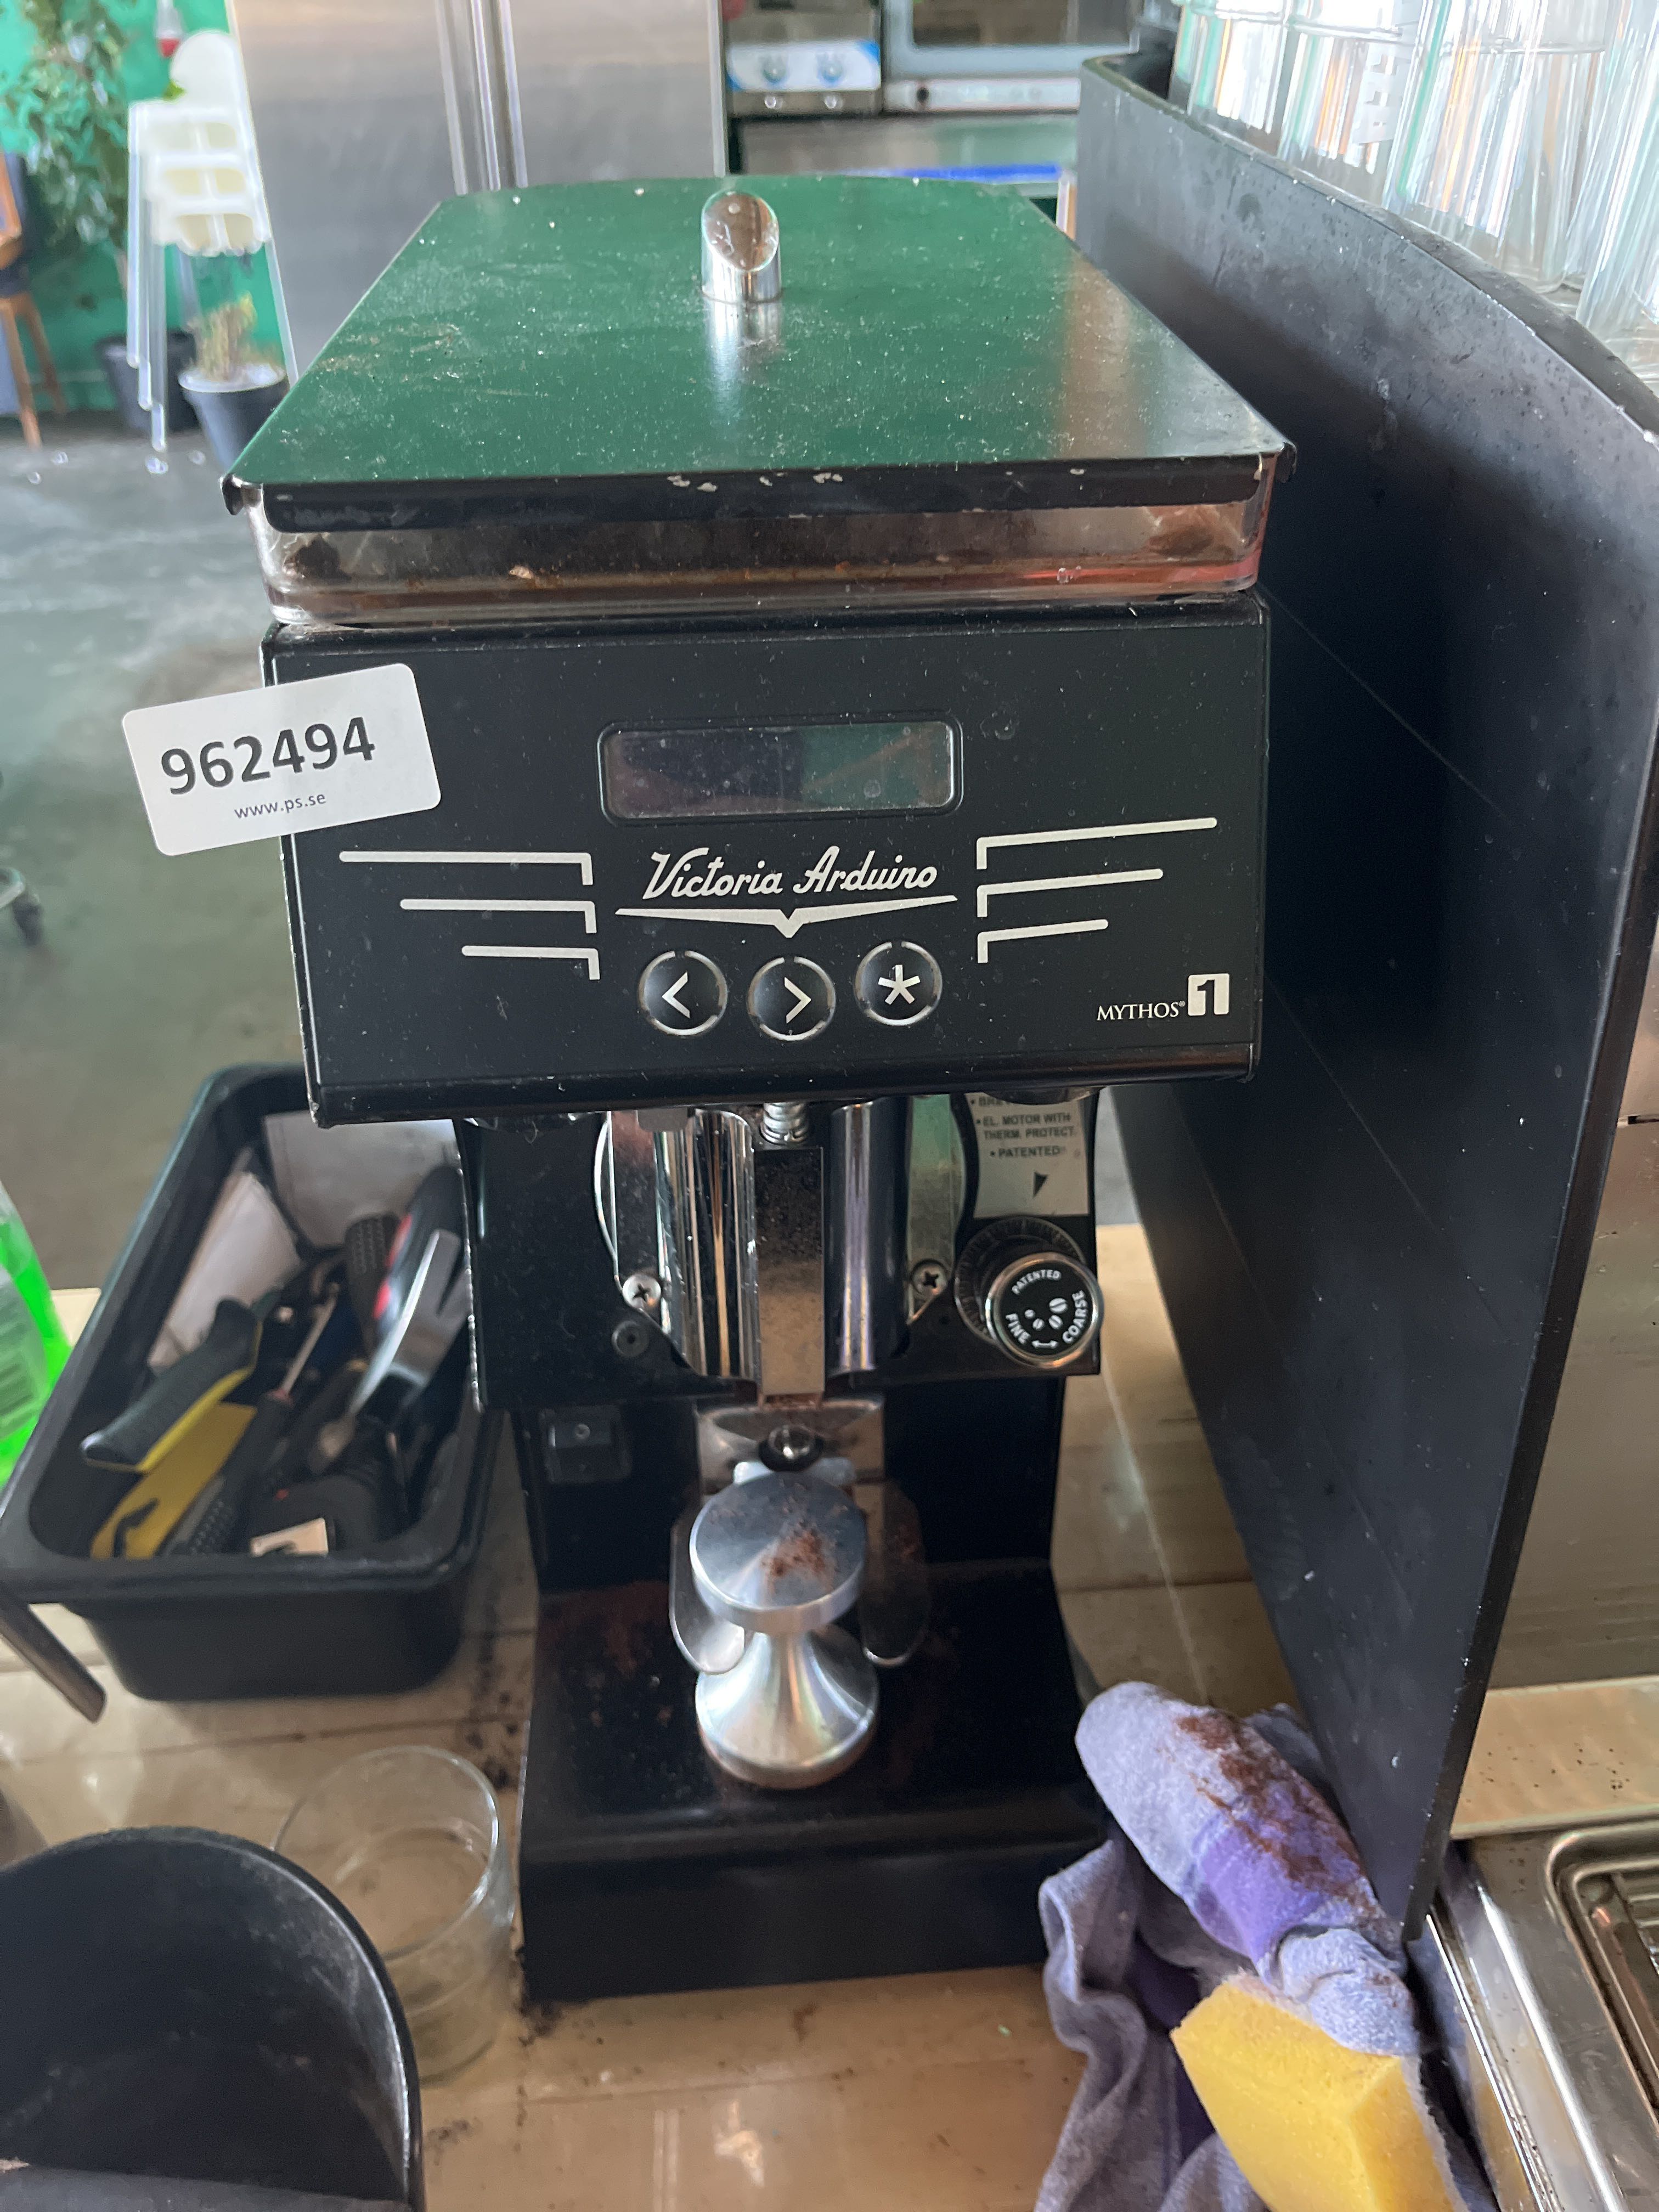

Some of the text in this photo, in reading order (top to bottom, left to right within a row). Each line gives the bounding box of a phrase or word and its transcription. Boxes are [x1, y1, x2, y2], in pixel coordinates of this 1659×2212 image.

[161, 716, 375, 794] 962494
[234, 792, 326, 819] www.ps.se
[642, 845, 937, 900] Victoria Arduino
[1002, 1114, 1041, 1125] MOTOR
[1043, 1113, 1071, 1124] WITH
[1011, 1269, 1062, 1295] PATENTED
[1006, 1313, 1032, 1345] FINE
[1062, 1290, 1088, 1344] COARSE
